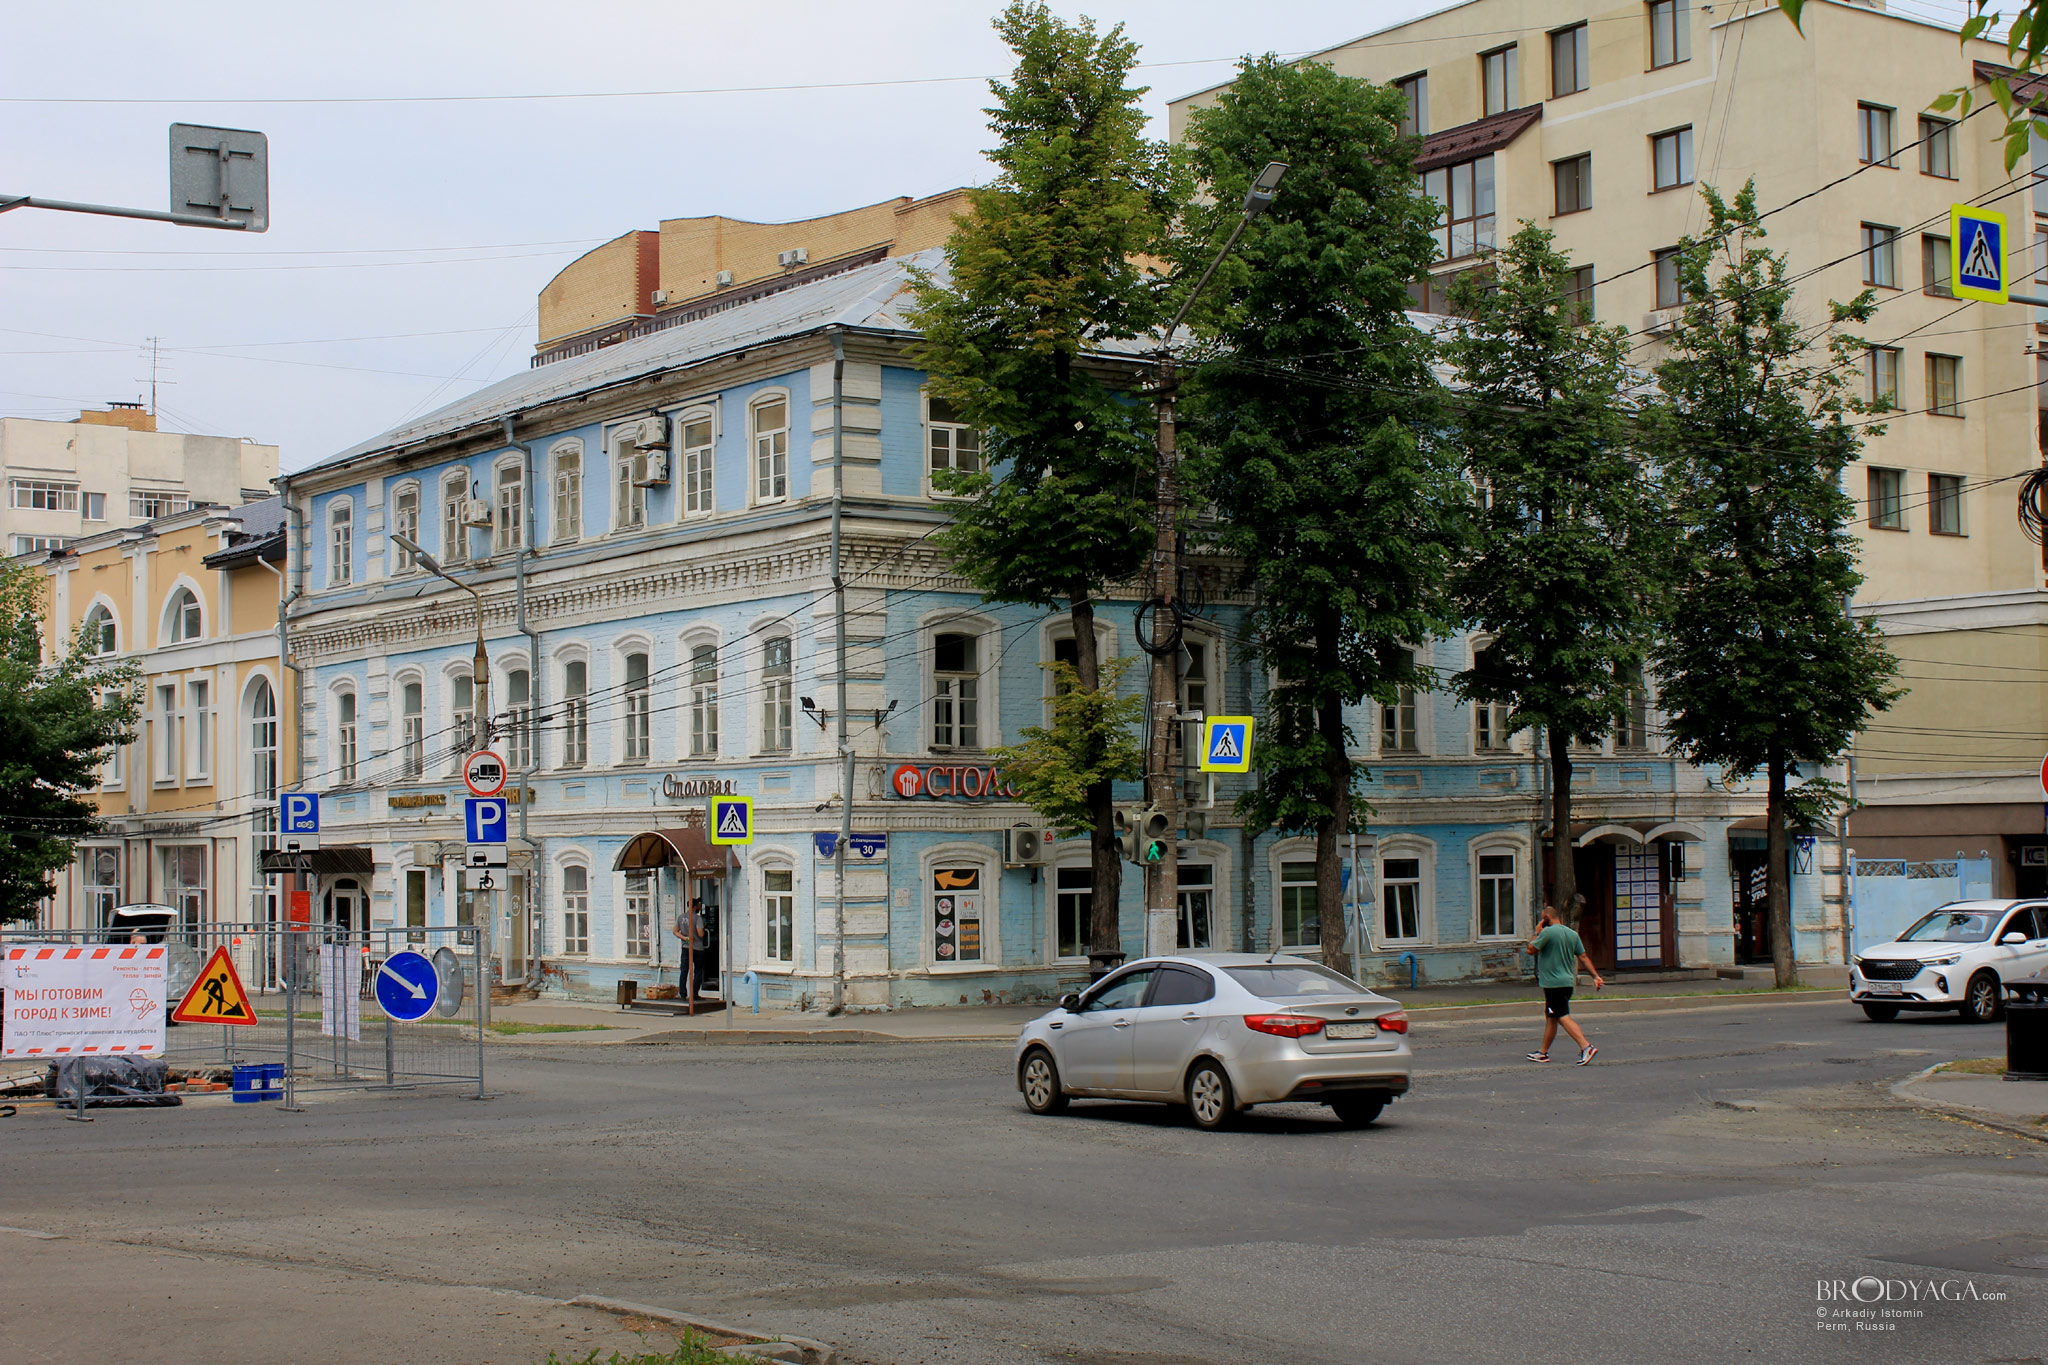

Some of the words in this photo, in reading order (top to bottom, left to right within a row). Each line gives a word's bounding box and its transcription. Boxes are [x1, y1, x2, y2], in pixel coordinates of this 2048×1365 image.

[663, 773, 737, 798] Столовая
[288, 796, 311, 830] P
[476, 801, 501, 840] P
[862, 845, 874, 855] 30
[14, 988, 38, 1001] МЫ
[42, 988, 103, 1000] ГОТОВИМ
[14, 1007, 58, 1021] ГОРОД
[61, 1007, 69, 1019] К
[72, 1007, 112, 1019] ЗИМЕ!
[56, 1030, 83, 1038] приносит
[123, 1028, 157, 1036] неудобства
